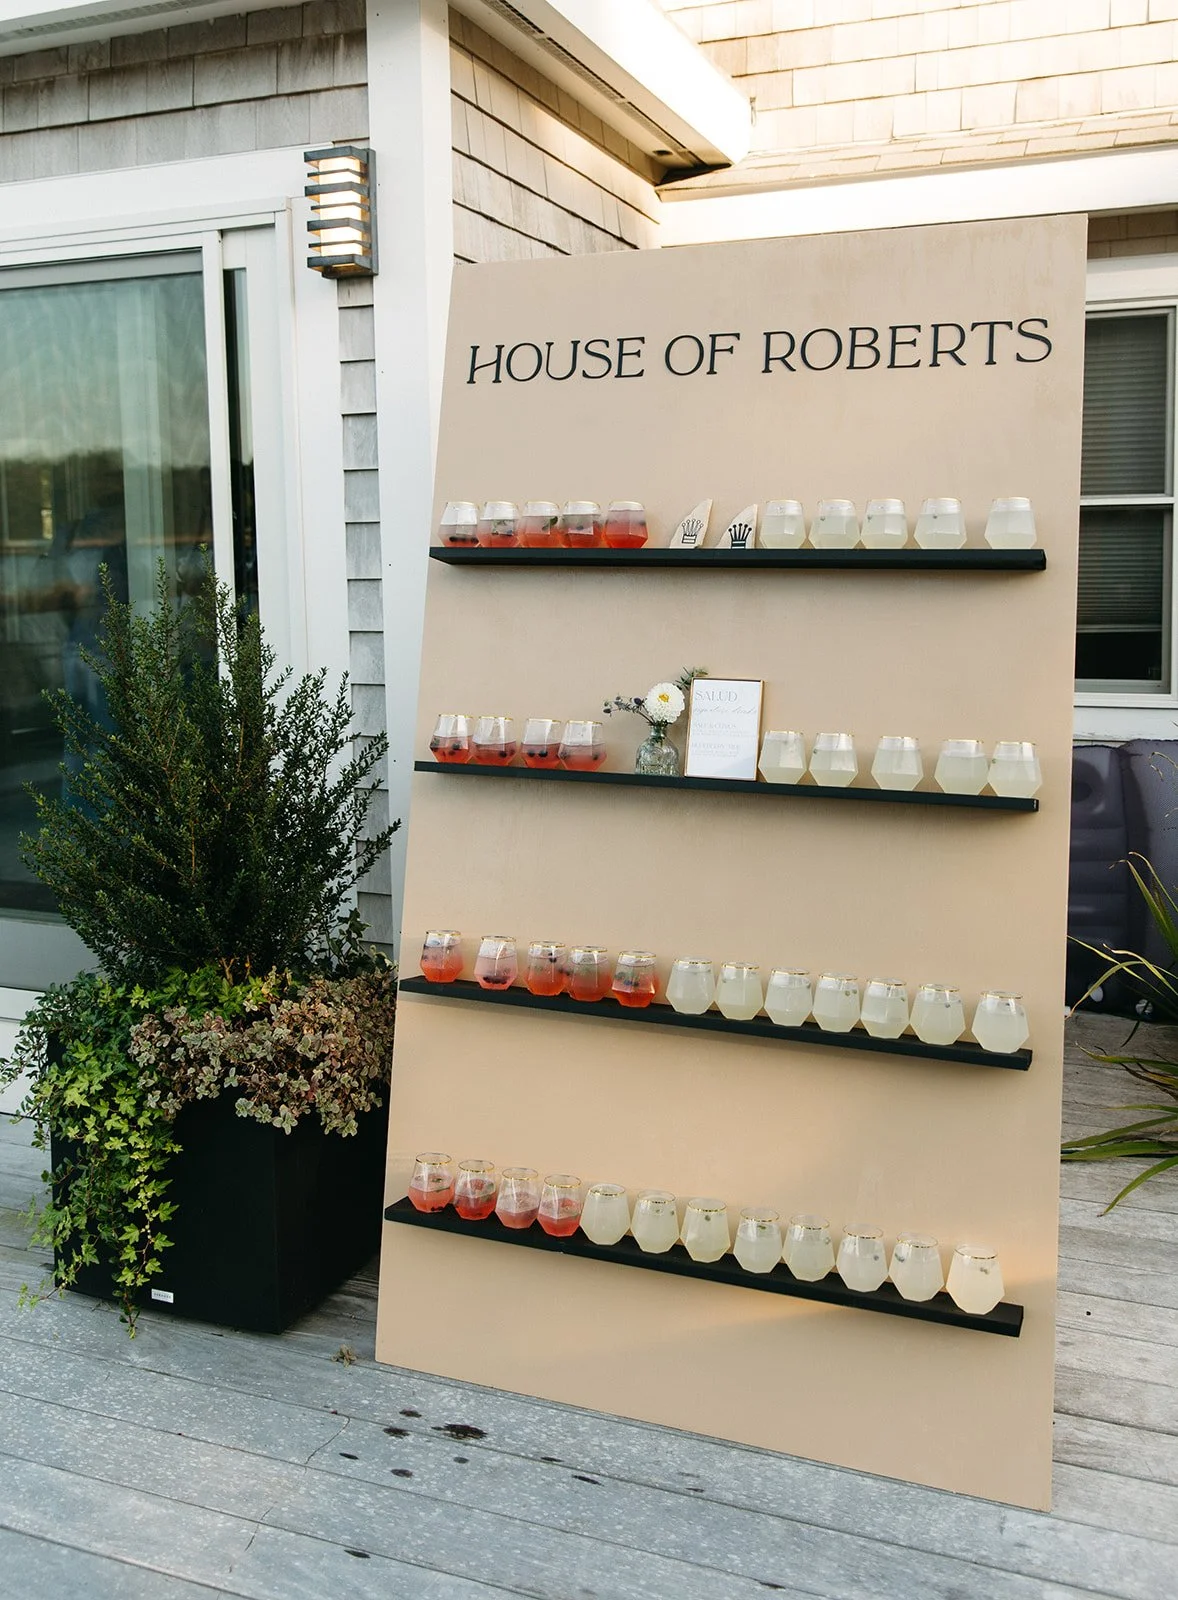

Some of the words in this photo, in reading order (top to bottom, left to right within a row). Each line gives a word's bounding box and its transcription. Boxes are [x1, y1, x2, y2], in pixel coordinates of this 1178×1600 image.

[466, 336, 646, 385] HOUSE
[664, 332, 741, 377] OF
[761, 318, 1053, 374] ROBERTS
[695, 690, 738, 702] SALUD
